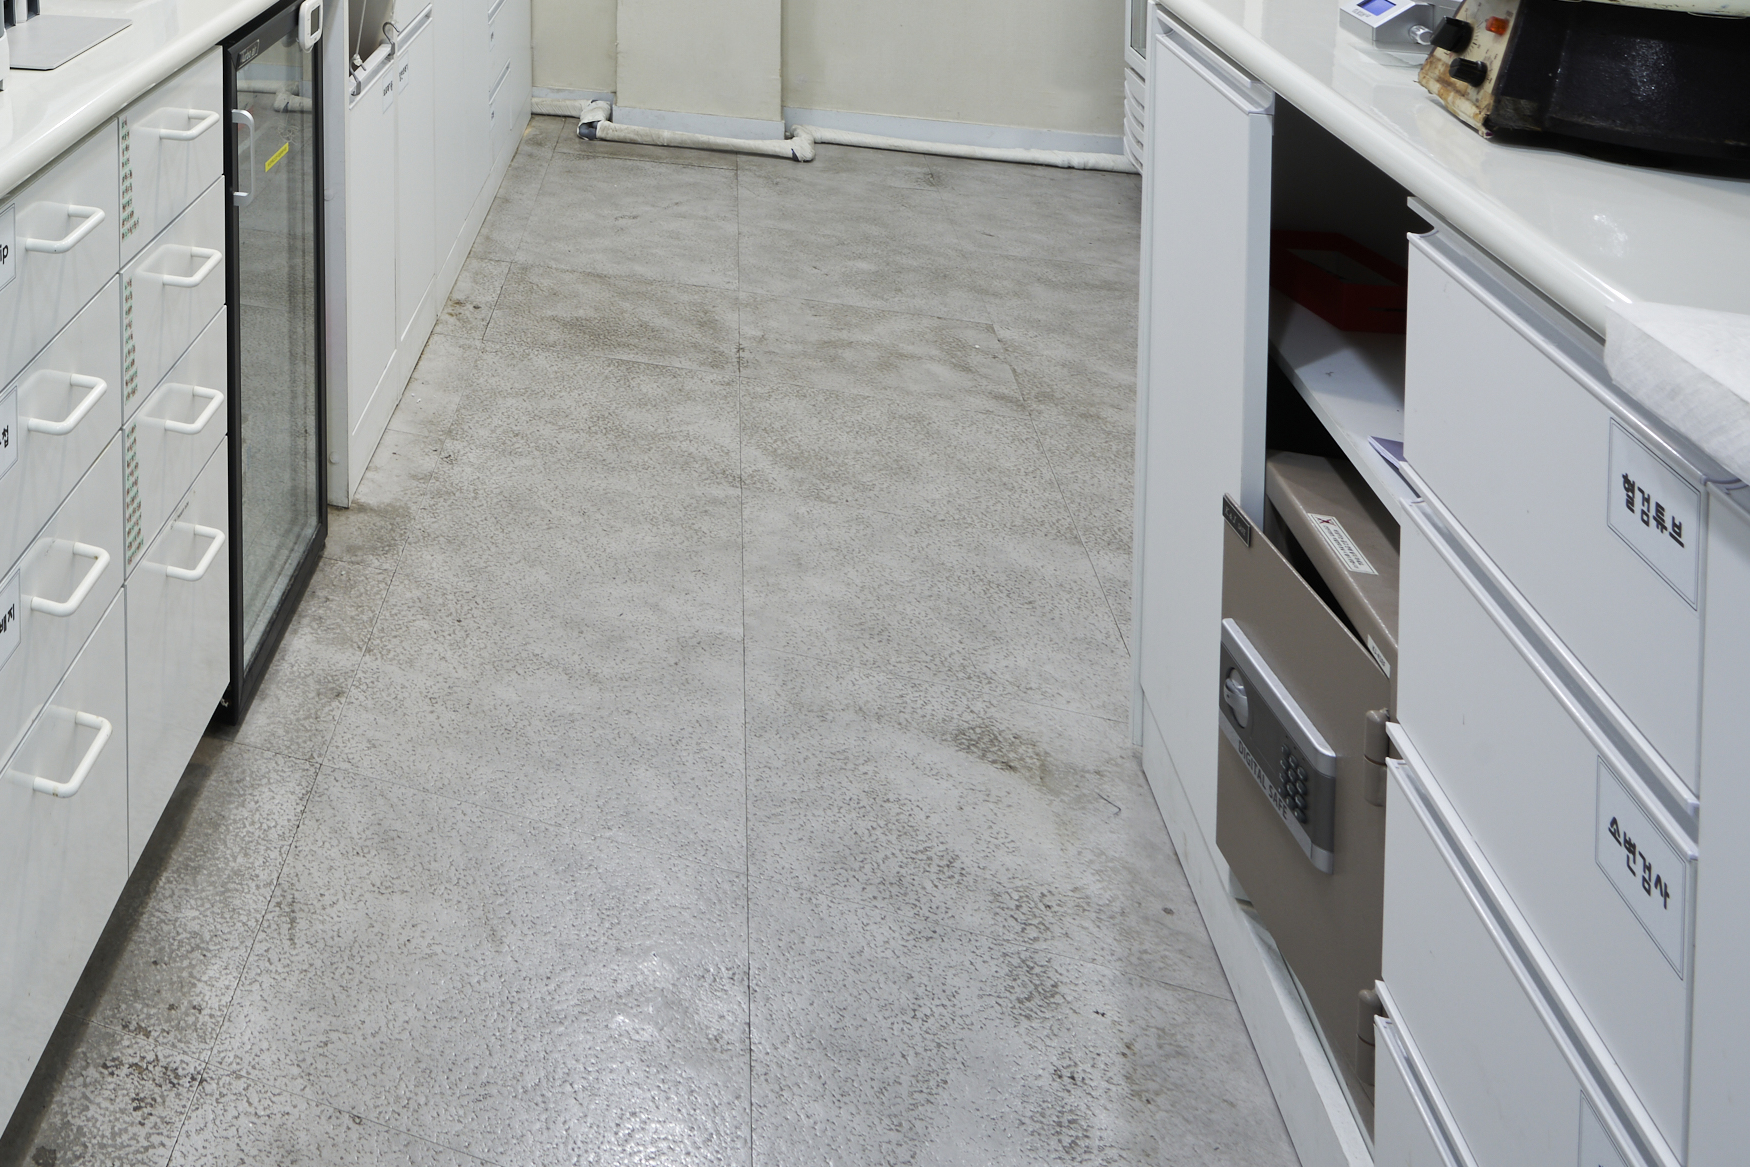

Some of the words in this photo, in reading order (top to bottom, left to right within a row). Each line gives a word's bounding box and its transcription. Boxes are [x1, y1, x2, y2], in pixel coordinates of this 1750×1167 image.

[1620, 470, 1685, 548] 혈검튜브
[1238, 739, 1266, 790] DIGITAL
[1268, 784, 1287, 820] SAFE
[1608, 815, 1670, 912] 소변검사
